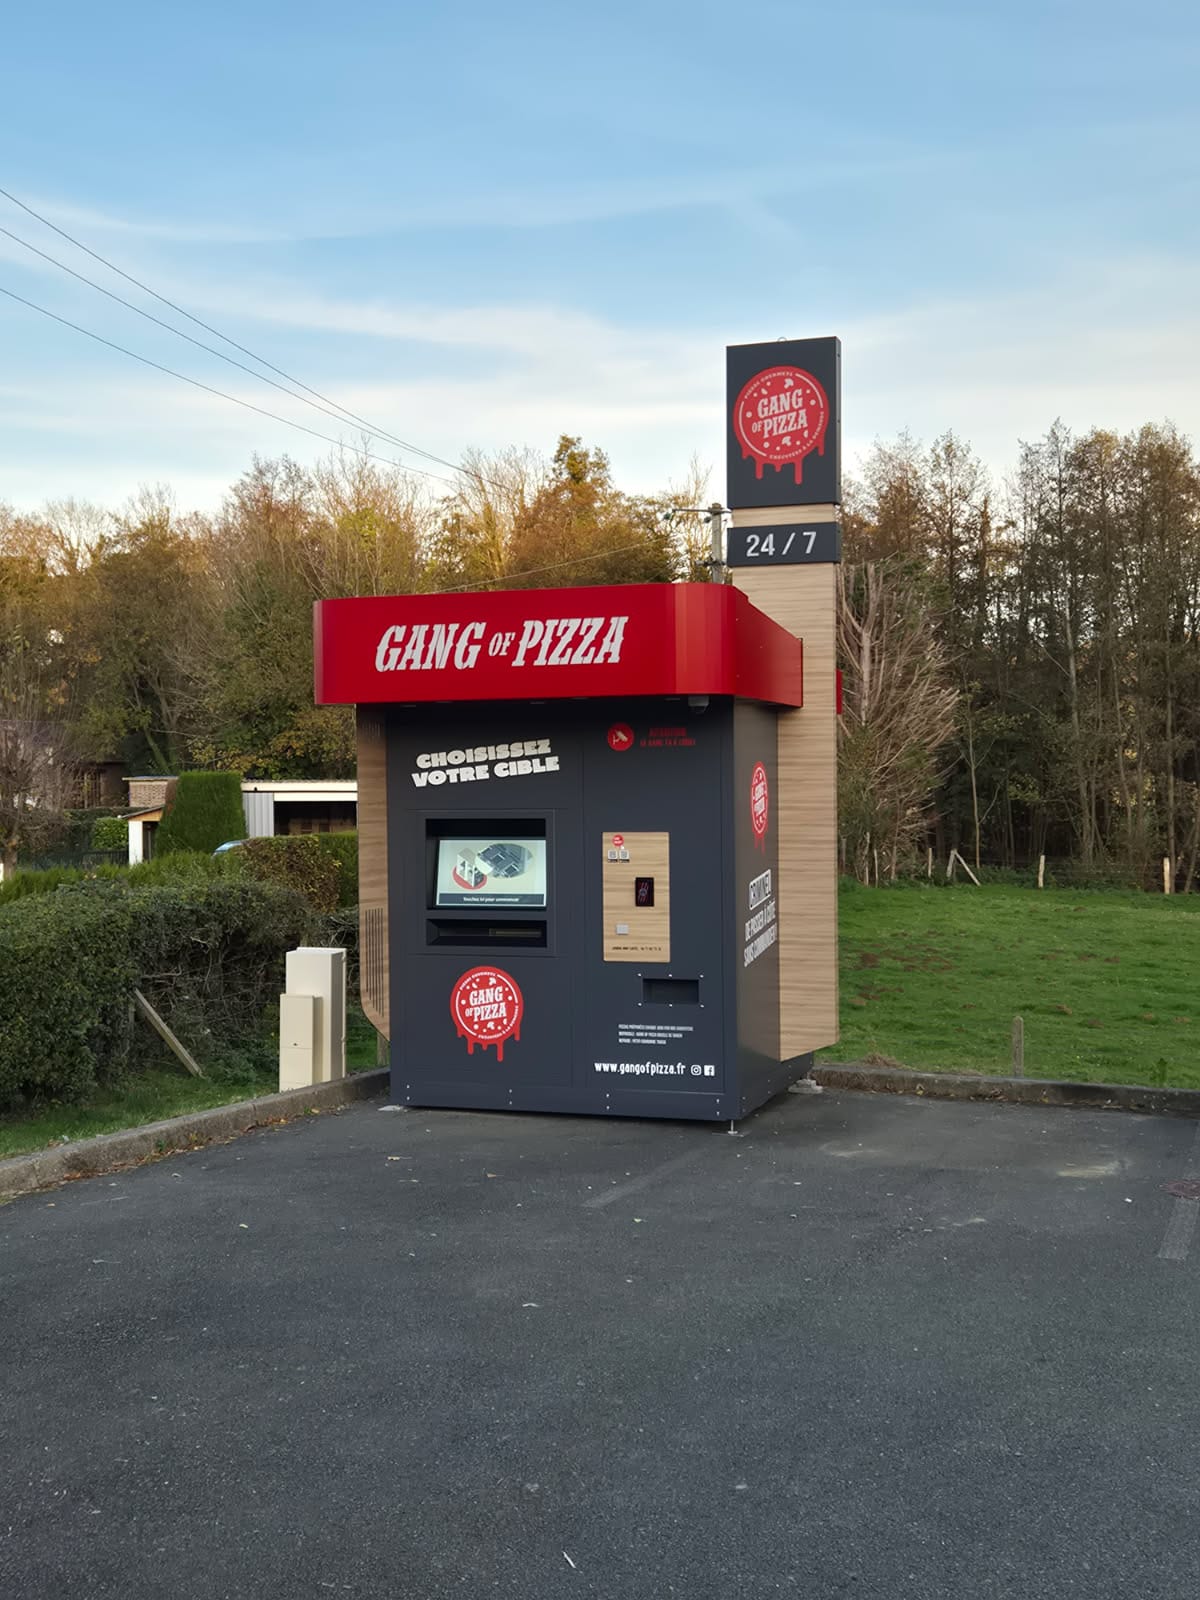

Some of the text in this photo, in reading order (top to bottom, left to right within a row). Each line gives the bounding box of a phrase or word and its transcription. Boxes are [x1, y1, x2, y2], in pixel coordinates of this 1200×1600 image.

[757, 388, 803, 419] GANG
[751, 409, 808, 439] OF PIZZA
[746, 533, 775, 557] 24
[802, 531, 817, 554] 7
[375, 616, 629, 672] GANG OF PIZZA
[416, 739, 551, 769] CHOISISSEZ
[411, 756, 560, 787] VOTRE CIBLE
[469, 986, 503, 1006] GANG
[464, 1007, 474, 1017] OF
[473, 1002, 507, 1022] PIZZA
[594, 1061, 686, 1077] www.gangofpizza.fr
